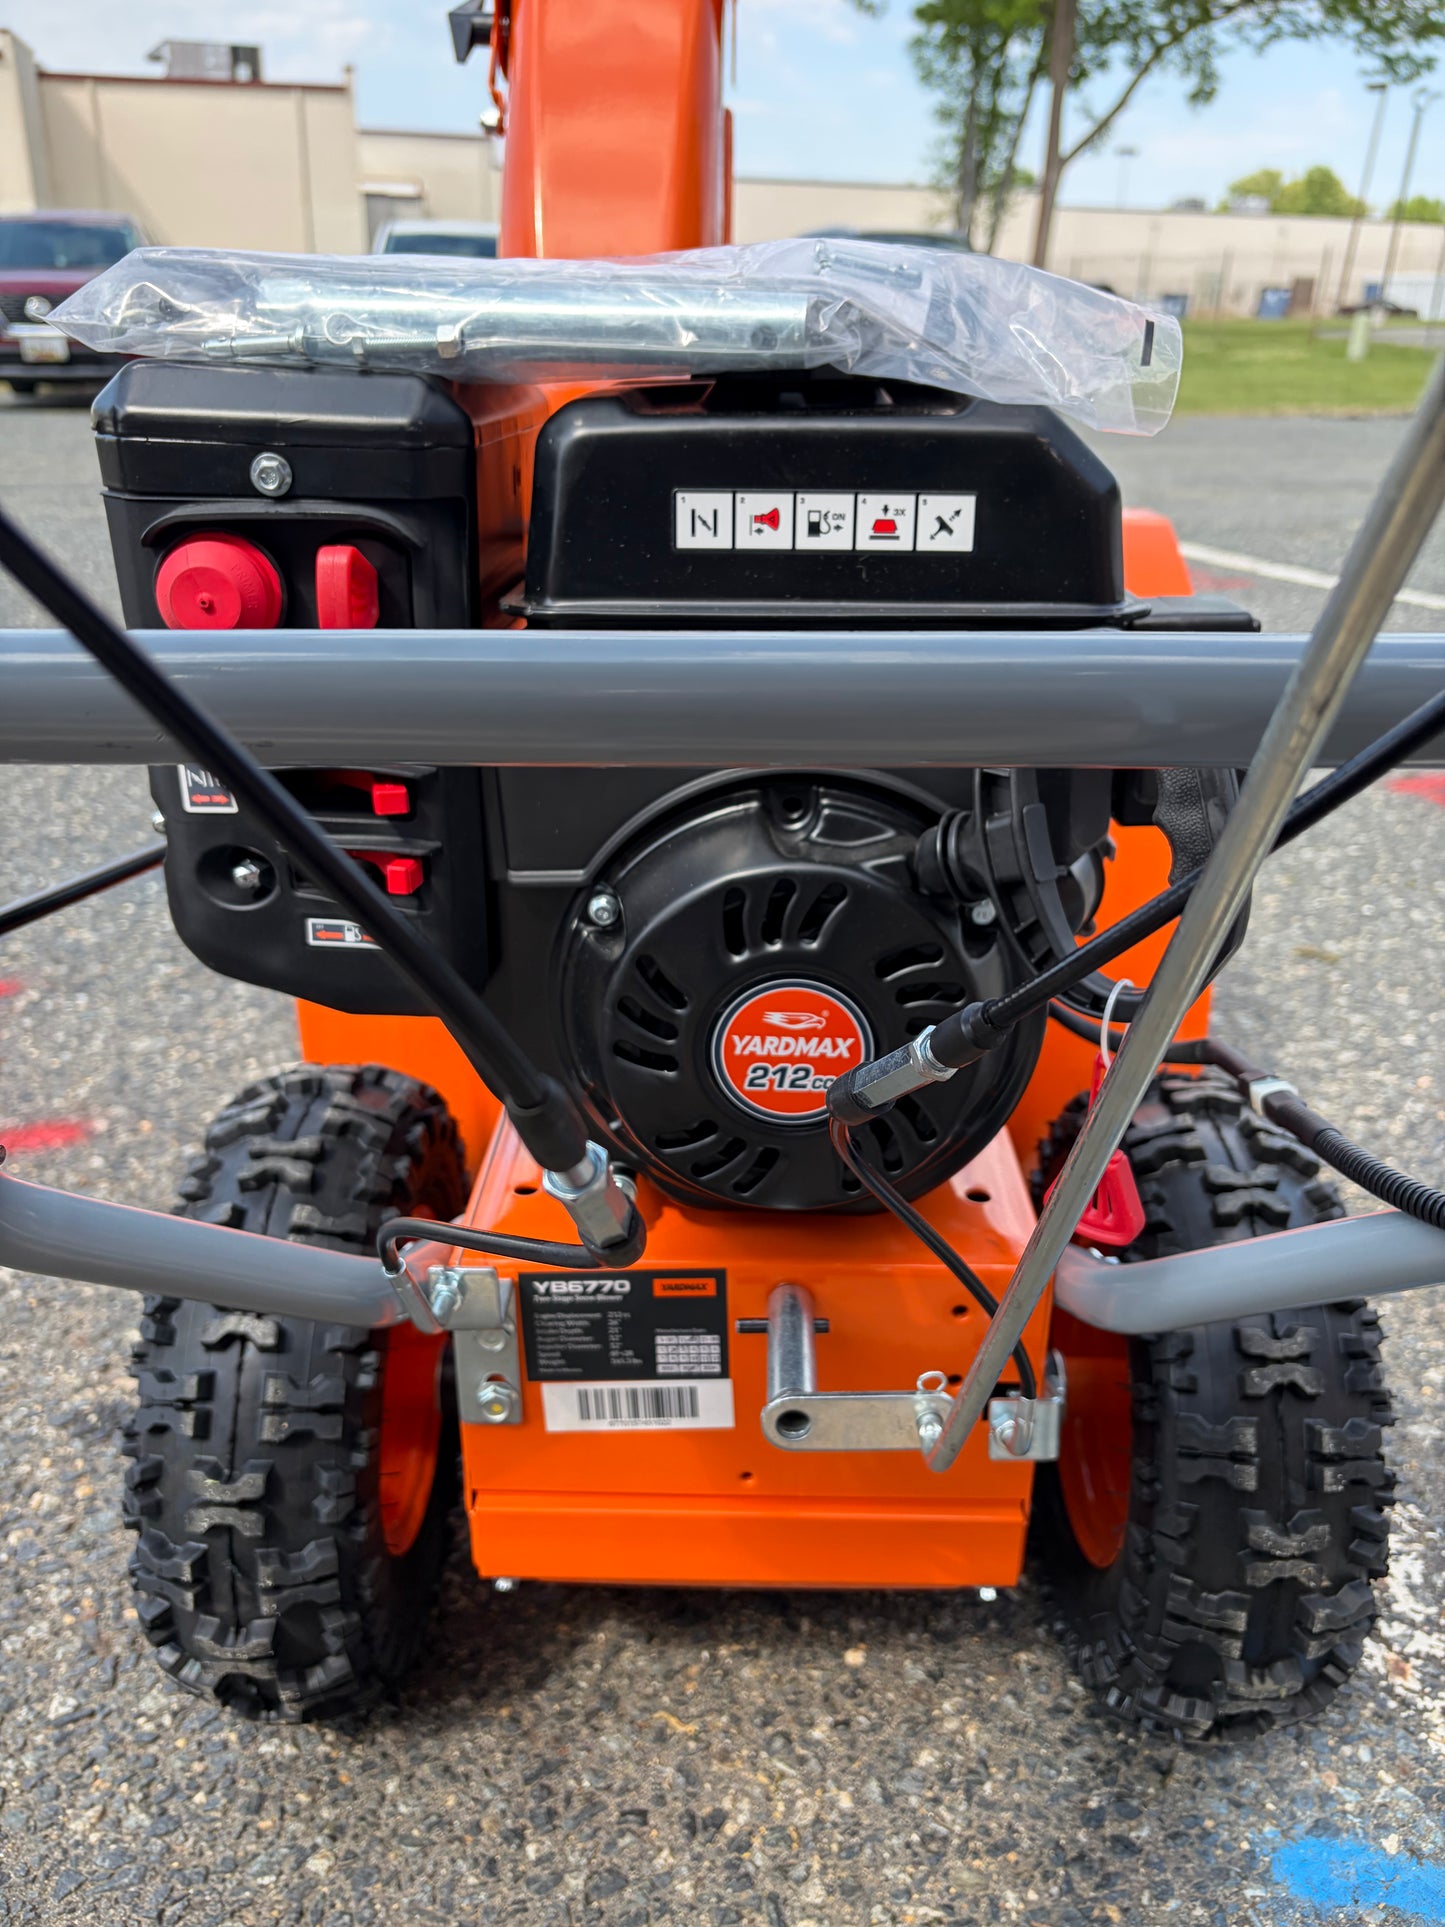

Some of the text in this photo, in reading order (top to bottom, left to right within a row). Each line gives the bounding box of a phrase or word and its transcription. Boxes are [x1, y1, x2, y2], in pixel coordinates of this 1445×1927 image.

[831, 513, 846, 521] ON
[893, 508, 906, 517] 3X
[731, 1034, 855, 1059] YARDMAX
[744, 1062, 835, 1091] 212cc
[532, 1279, 631, 1294] YB6770
